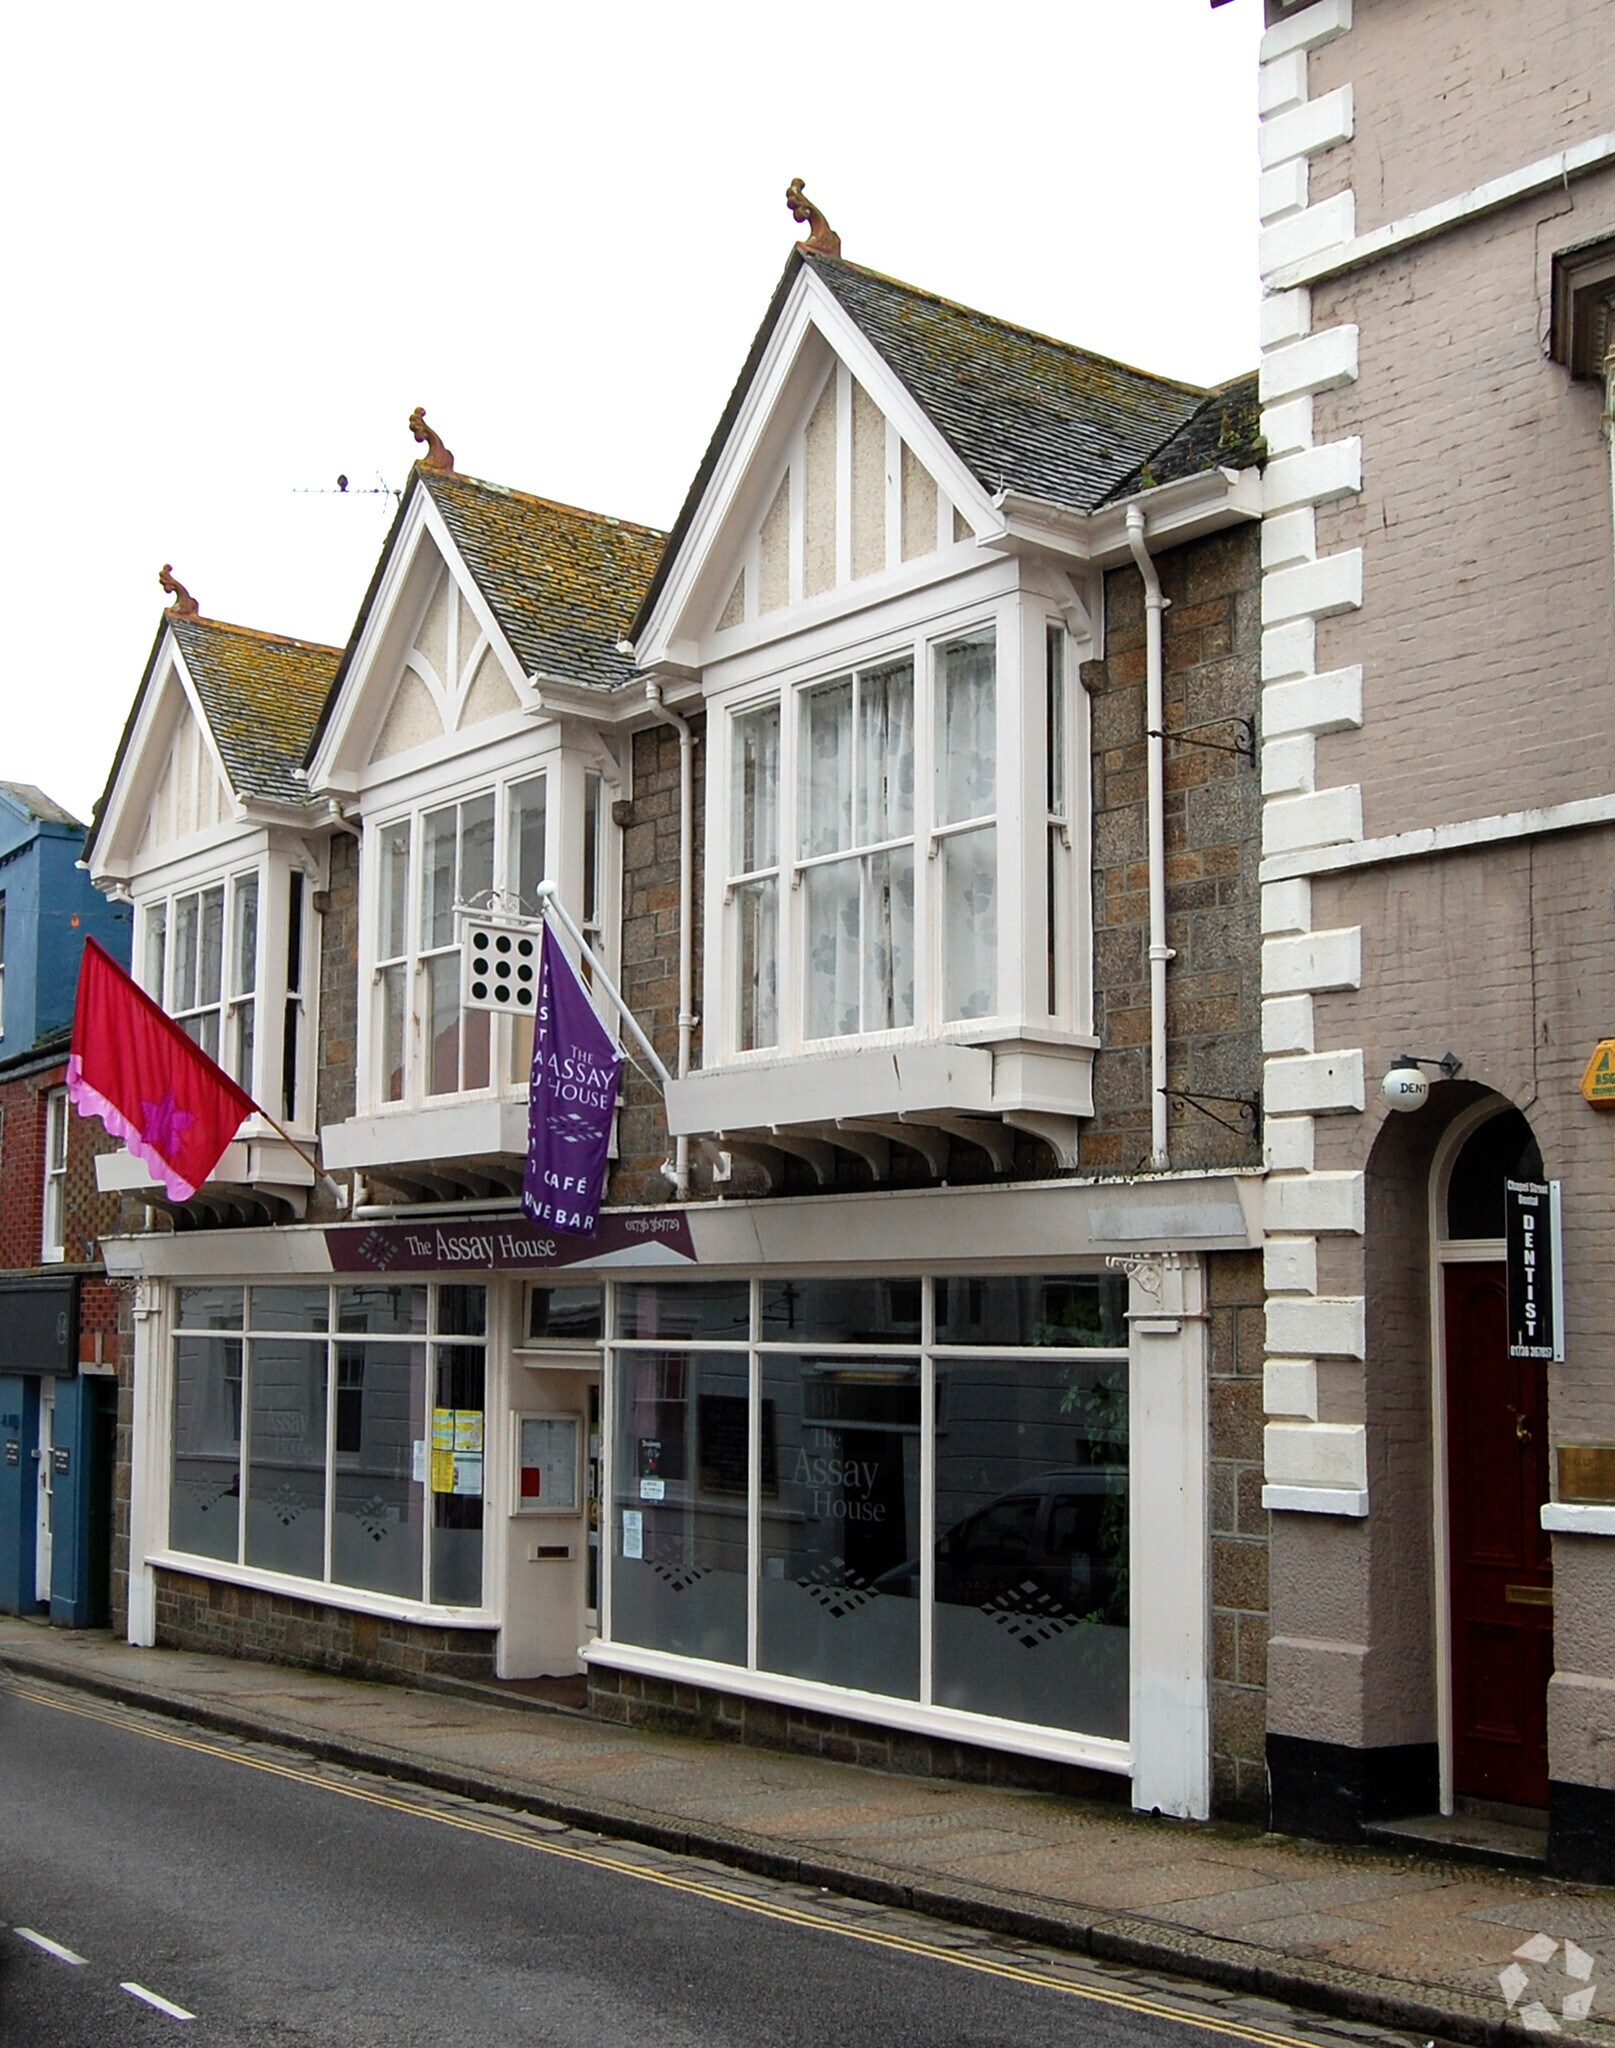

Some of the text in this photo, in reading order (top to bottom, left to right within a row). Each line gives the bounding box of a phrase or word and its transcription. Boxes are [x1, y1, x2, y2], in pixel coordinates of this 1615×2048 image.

[570, 1044, 594, 1066] THE
[548, 1052, 614, 1091] ASSAY
[548, 1077, 608, 1110] HOUSE
[544, 1170, 588, 1195] CAFÉ
[1529, 1181, 1549, 1195] Street
[524, 1190, 594, 1230] WNE BAR
[624, 1217, 649, 1233] 01736
[405, 1228, 557, 1269] The Assay House
[1522, 1213, 1538, 1337] DENTIST
[811, 1427, 842, 1449] The
[792, 1446, 879, 1500] Assay
[812, 1490, 887, 1522] House
